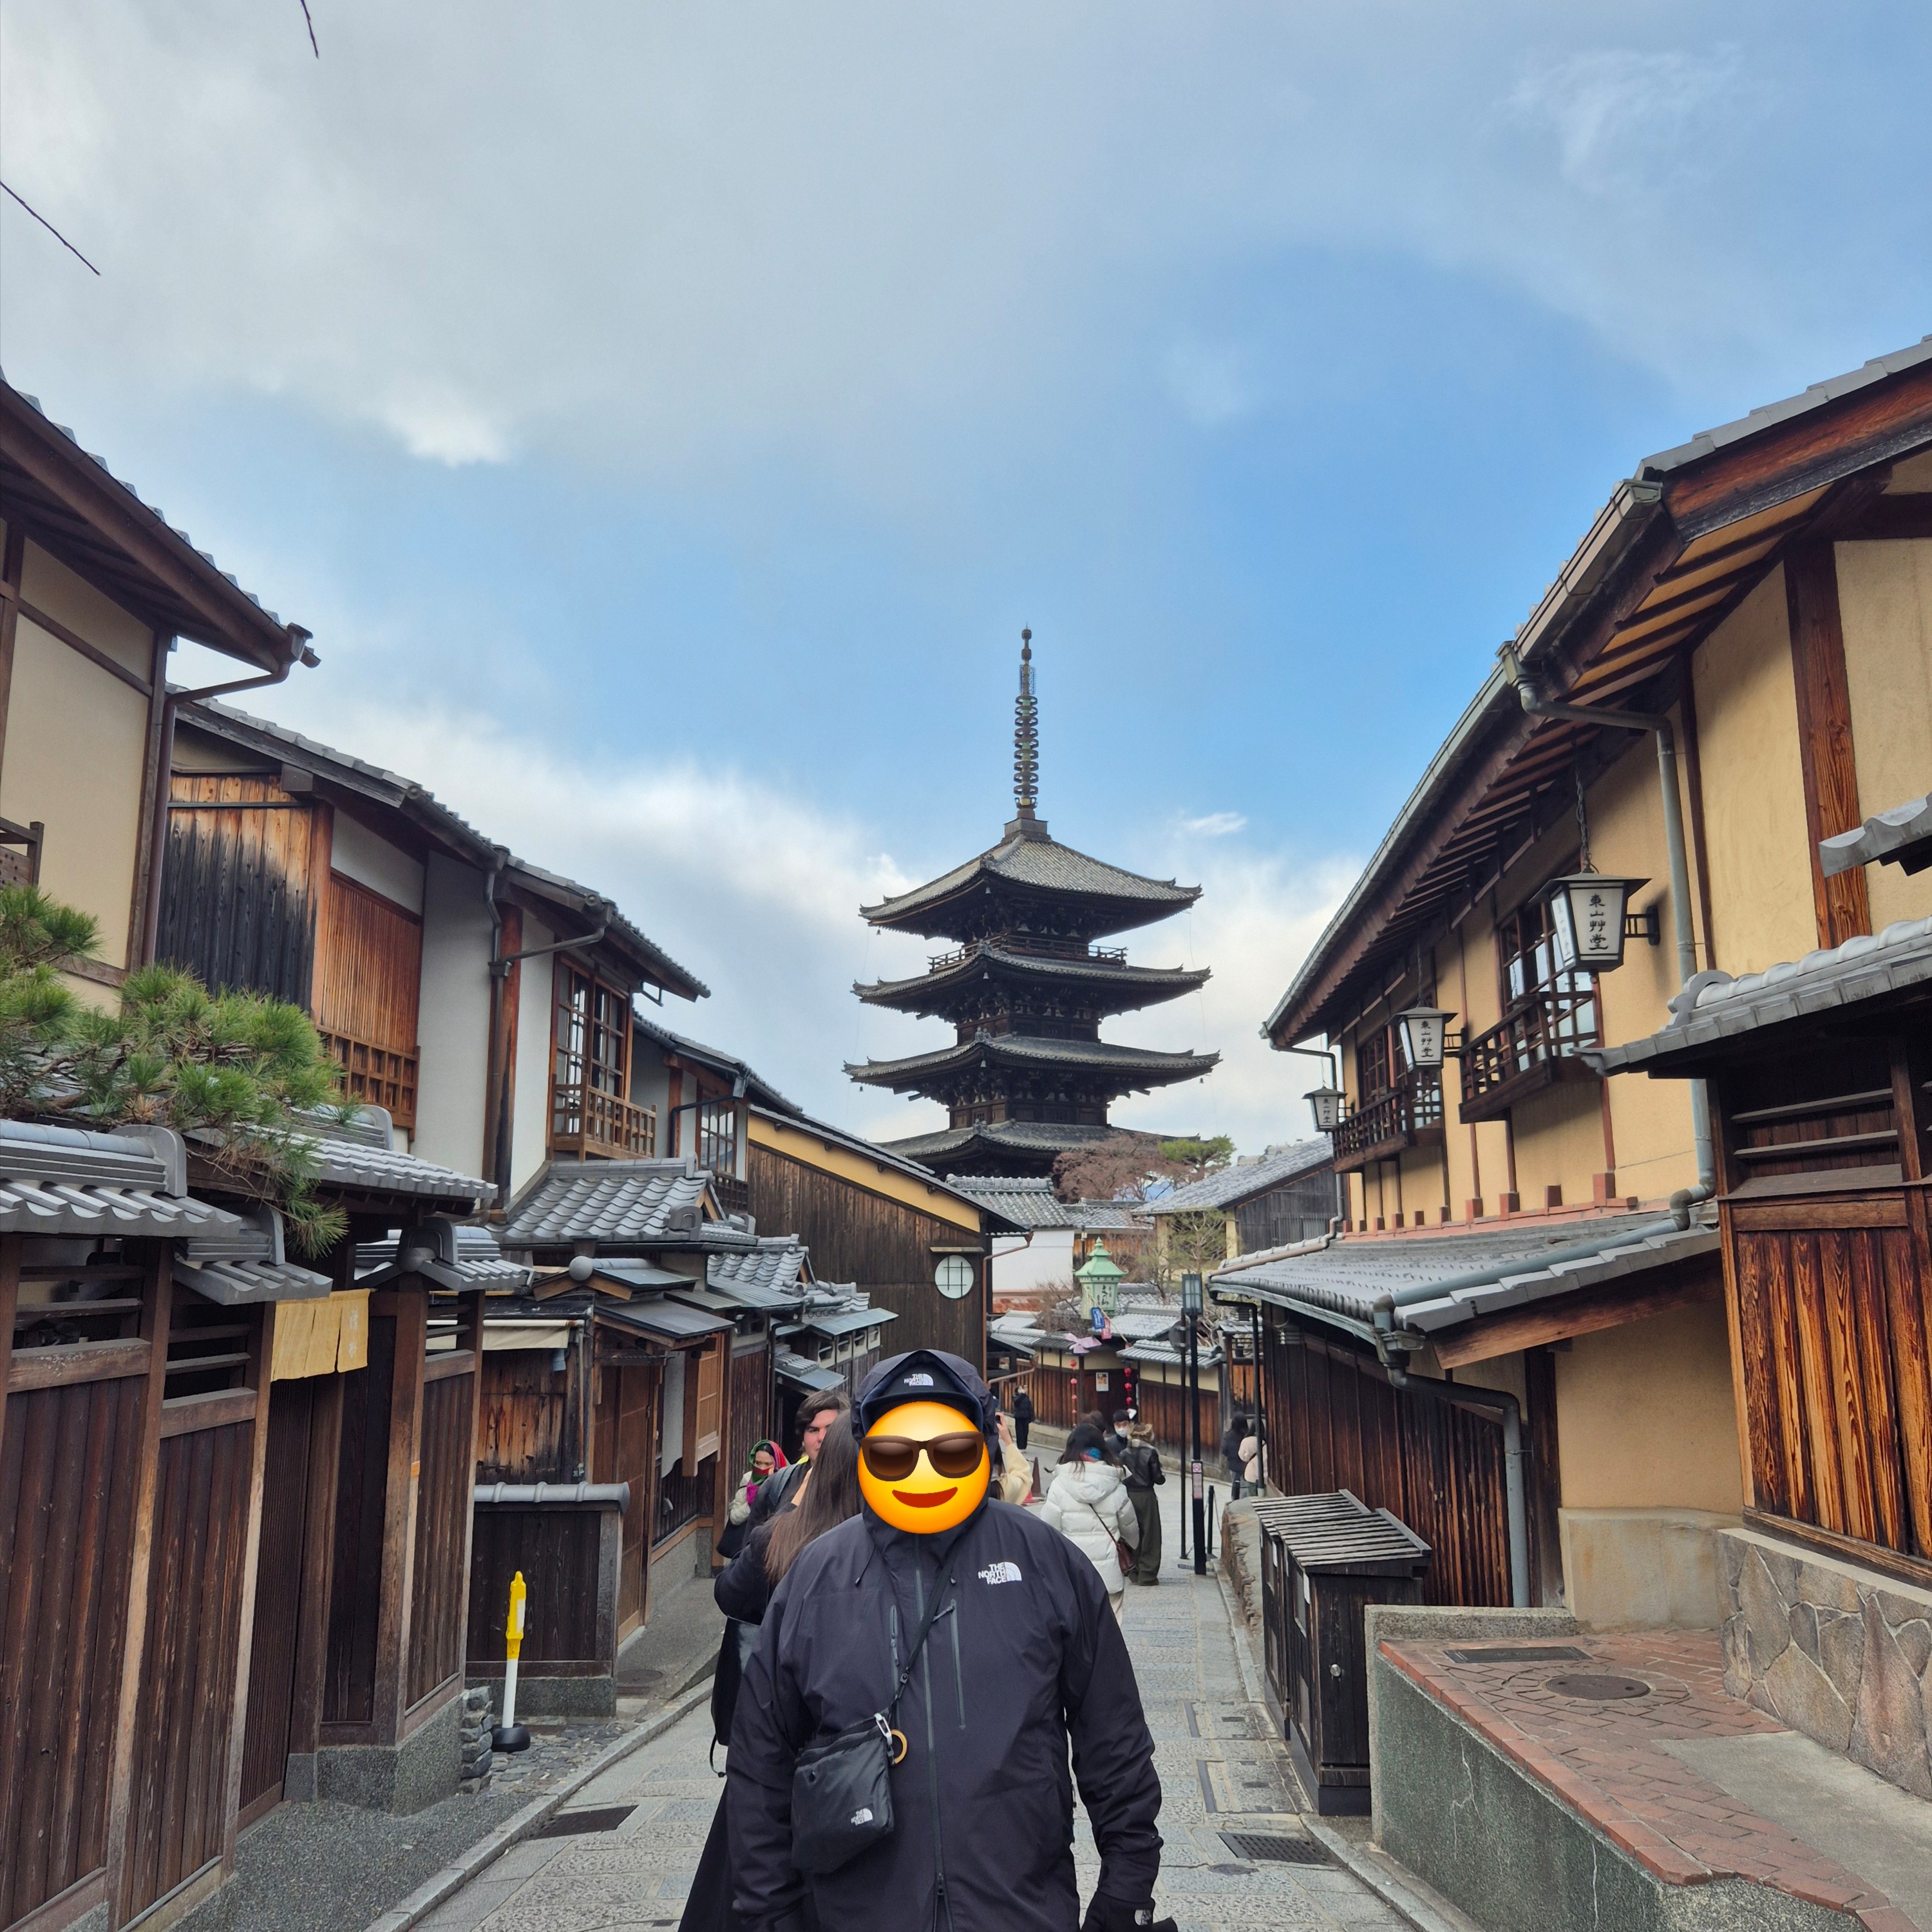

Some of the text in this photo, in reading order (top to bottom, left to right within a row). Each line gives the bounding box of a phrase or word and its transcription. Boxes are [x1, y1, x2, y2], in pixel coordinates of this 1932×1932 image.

[988, 1562, 1005, 1572] THE
[978, 1567, 1007, 1579] NORTH
[987, 1576, 1007, 1585] FACE
